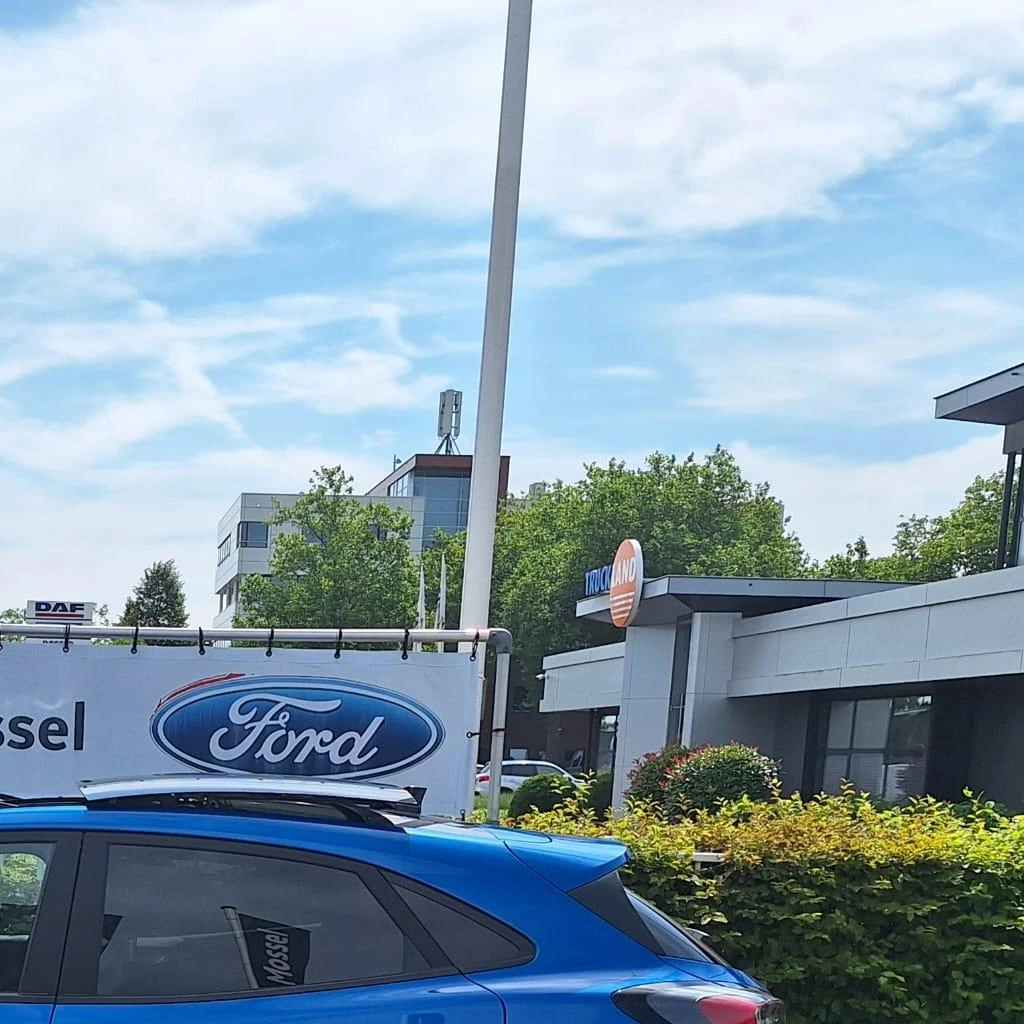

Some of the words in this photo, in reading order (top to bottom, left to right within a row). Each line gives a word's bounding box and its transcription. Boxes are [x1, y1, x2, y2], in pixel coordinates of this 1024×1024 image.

[35, 602, 84, 613] DAF
[209, 692, 385, 766] Ford
[257, 928, 296, 986] Mossel
